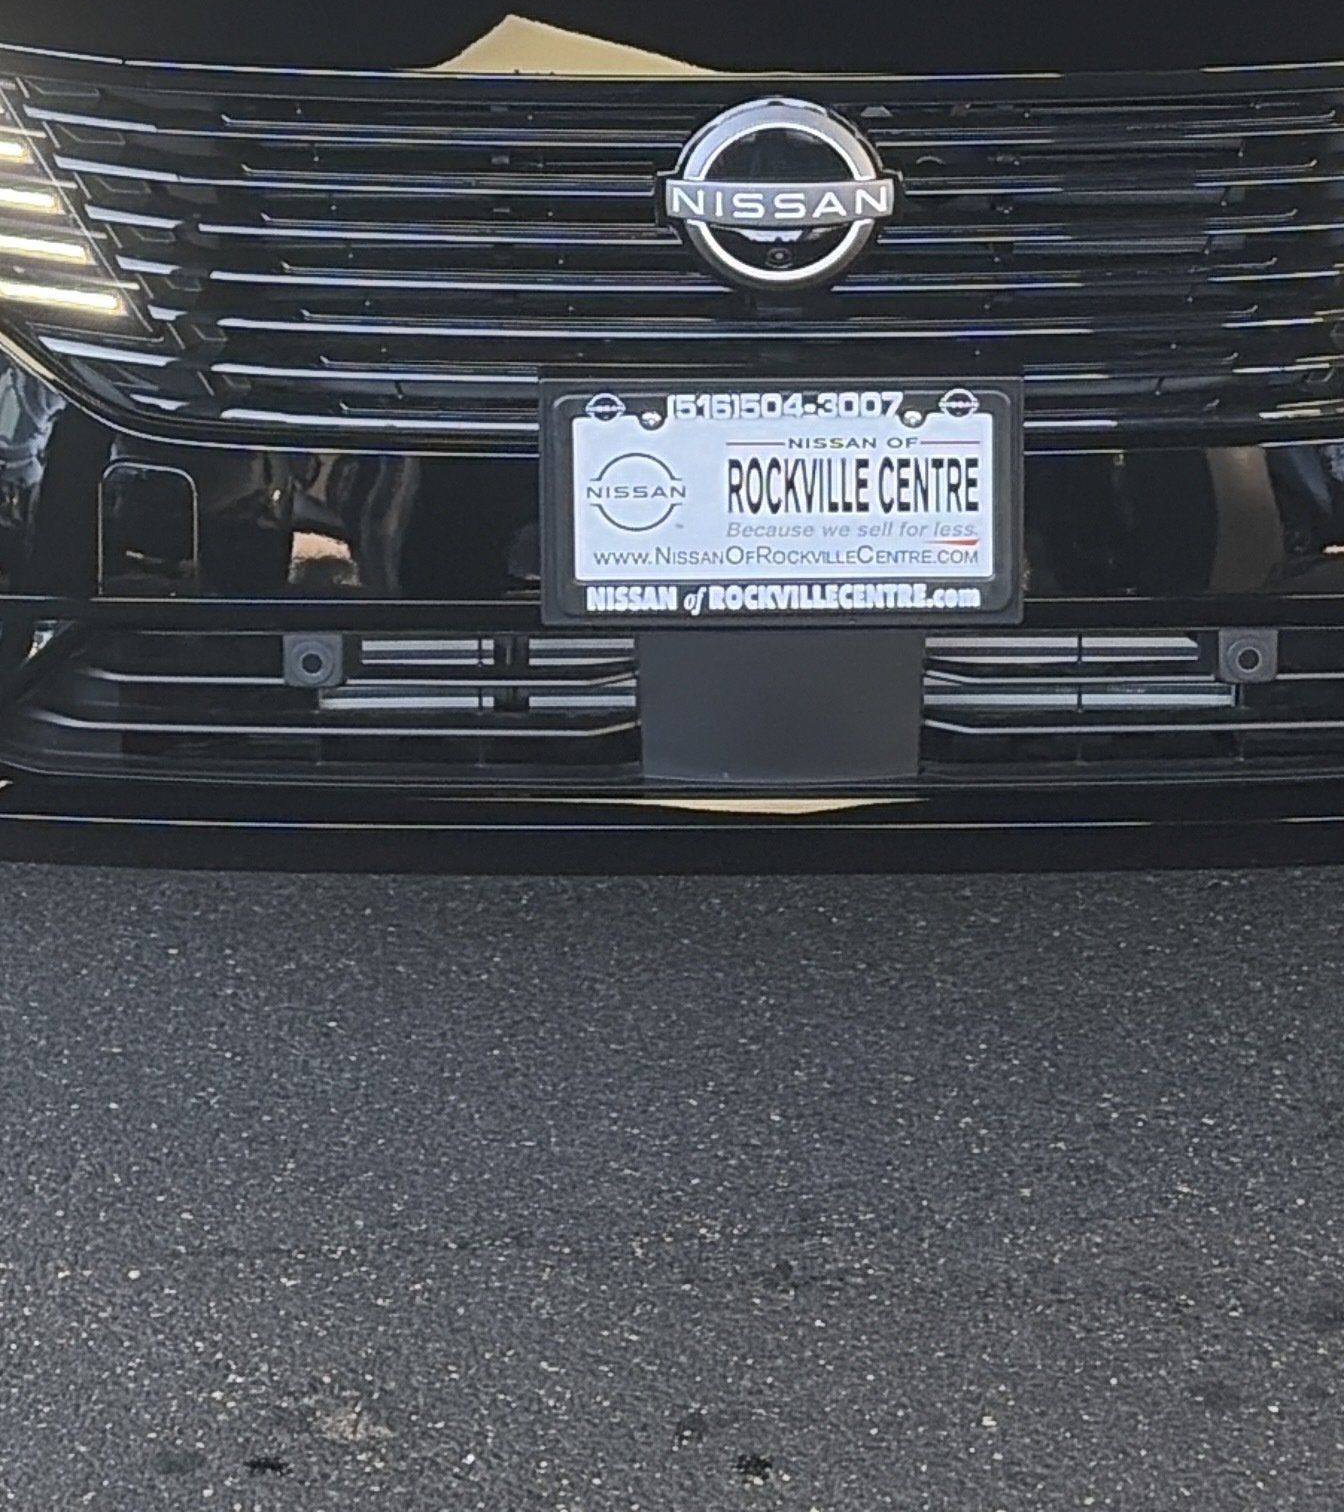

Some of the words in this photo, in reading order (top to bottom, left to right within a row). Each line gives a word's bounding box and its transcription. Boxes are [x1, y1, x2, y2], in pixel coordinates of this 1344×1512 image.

[671, 185, 888, 219] NISSAN
[788, 437, 877, 449] NISSAN
[886, 437, 918, 449] OF
[586, 485, 686, 499] NISSAN
[727, 456, 871, 515] ROCKVILLE
[878, 456, 980, 514] CENTRE
[726, 522, 814, 538] Because
[822, 524, 850, 538] we
[857, 521, 894, 538] sell
[899, 521, 929, 538] for
[933, 520, 979, 538] less.
[586, 585, 678, 612] NISSAN
[683, 586, 707, 616] of
[708, 583, 981, 611] ROCKVILLECENTRE.com
